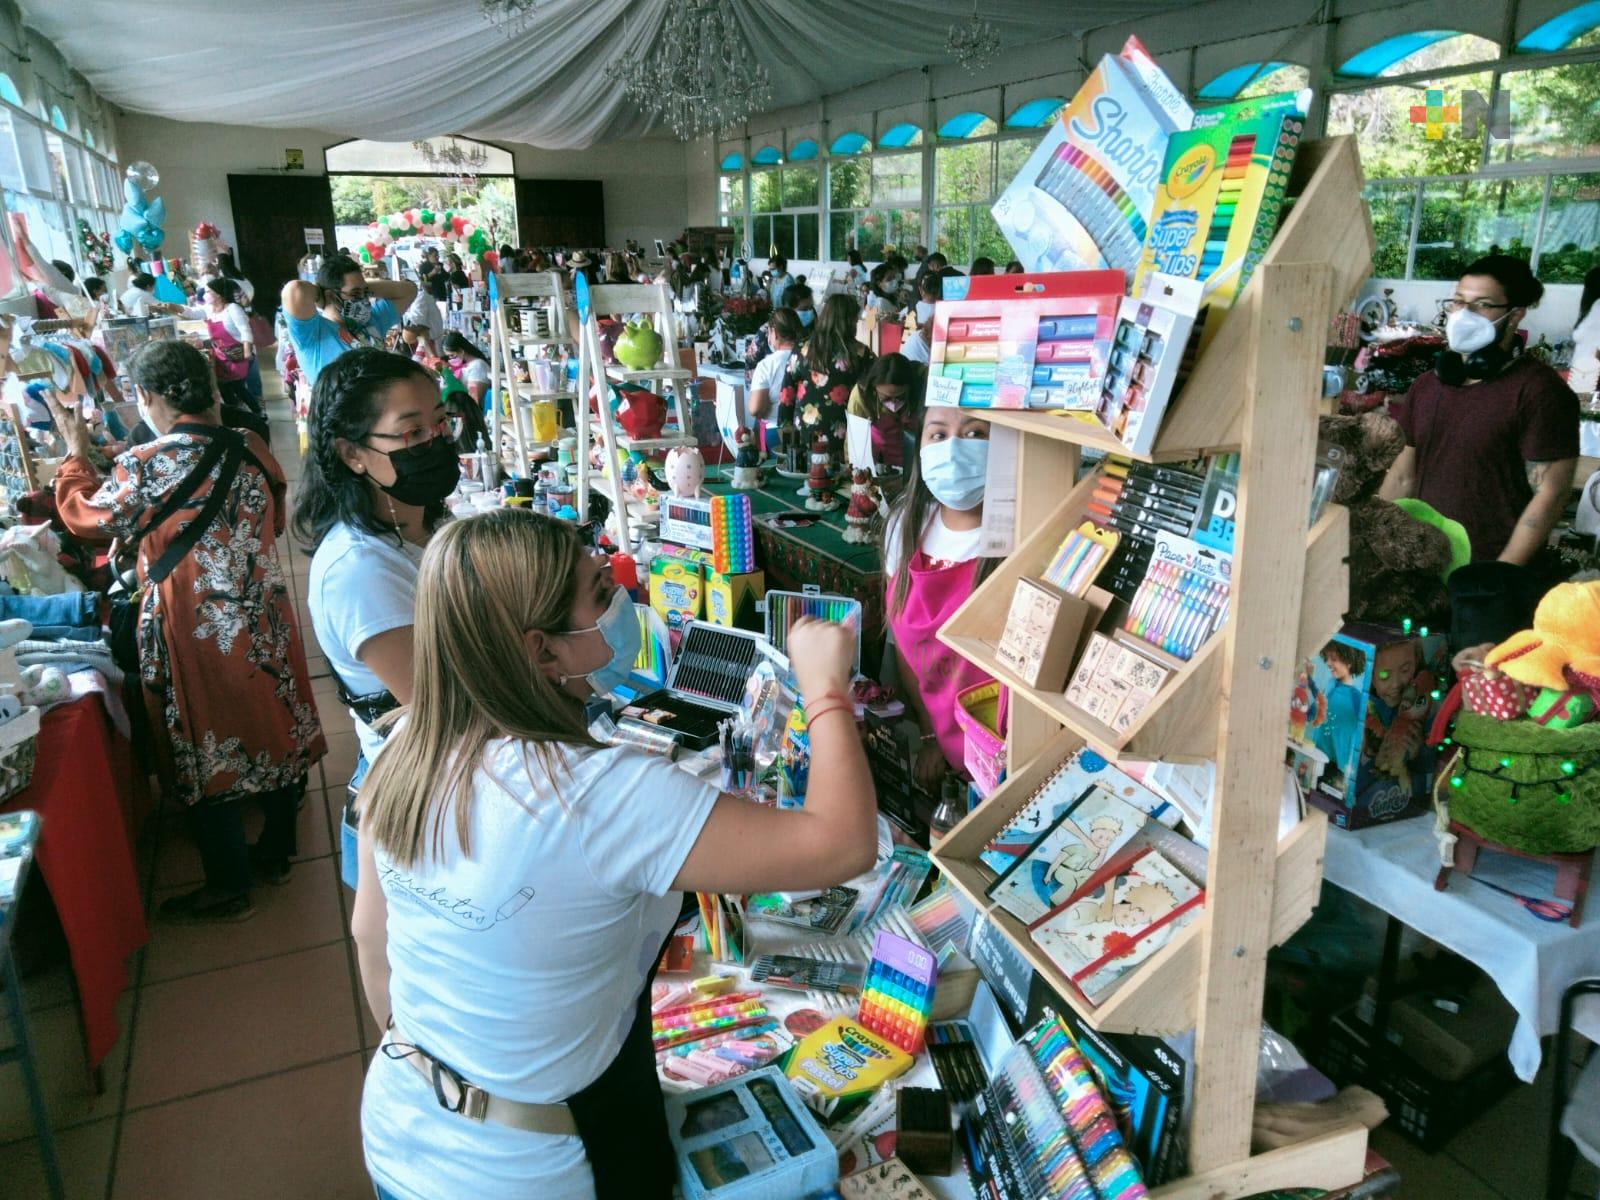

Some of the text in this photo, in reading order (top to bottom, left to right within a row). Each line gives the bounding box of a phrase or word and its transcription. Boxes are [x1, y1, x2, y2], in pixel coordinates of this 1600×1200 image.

[1175, 155, 1208, 177] Crayola
[1149, 223, 1197, 251] Super
[1161, 252, 1197, 276] Tips
[1157, 541, 1217, 577] Paper Mate
[845, 1026, 891, 1056] Crayola
[823, 1042, 864, 1069] Super
[801, 1058, 847, 1090] Pastel
[831, 1059, 857, 1080] Tips
